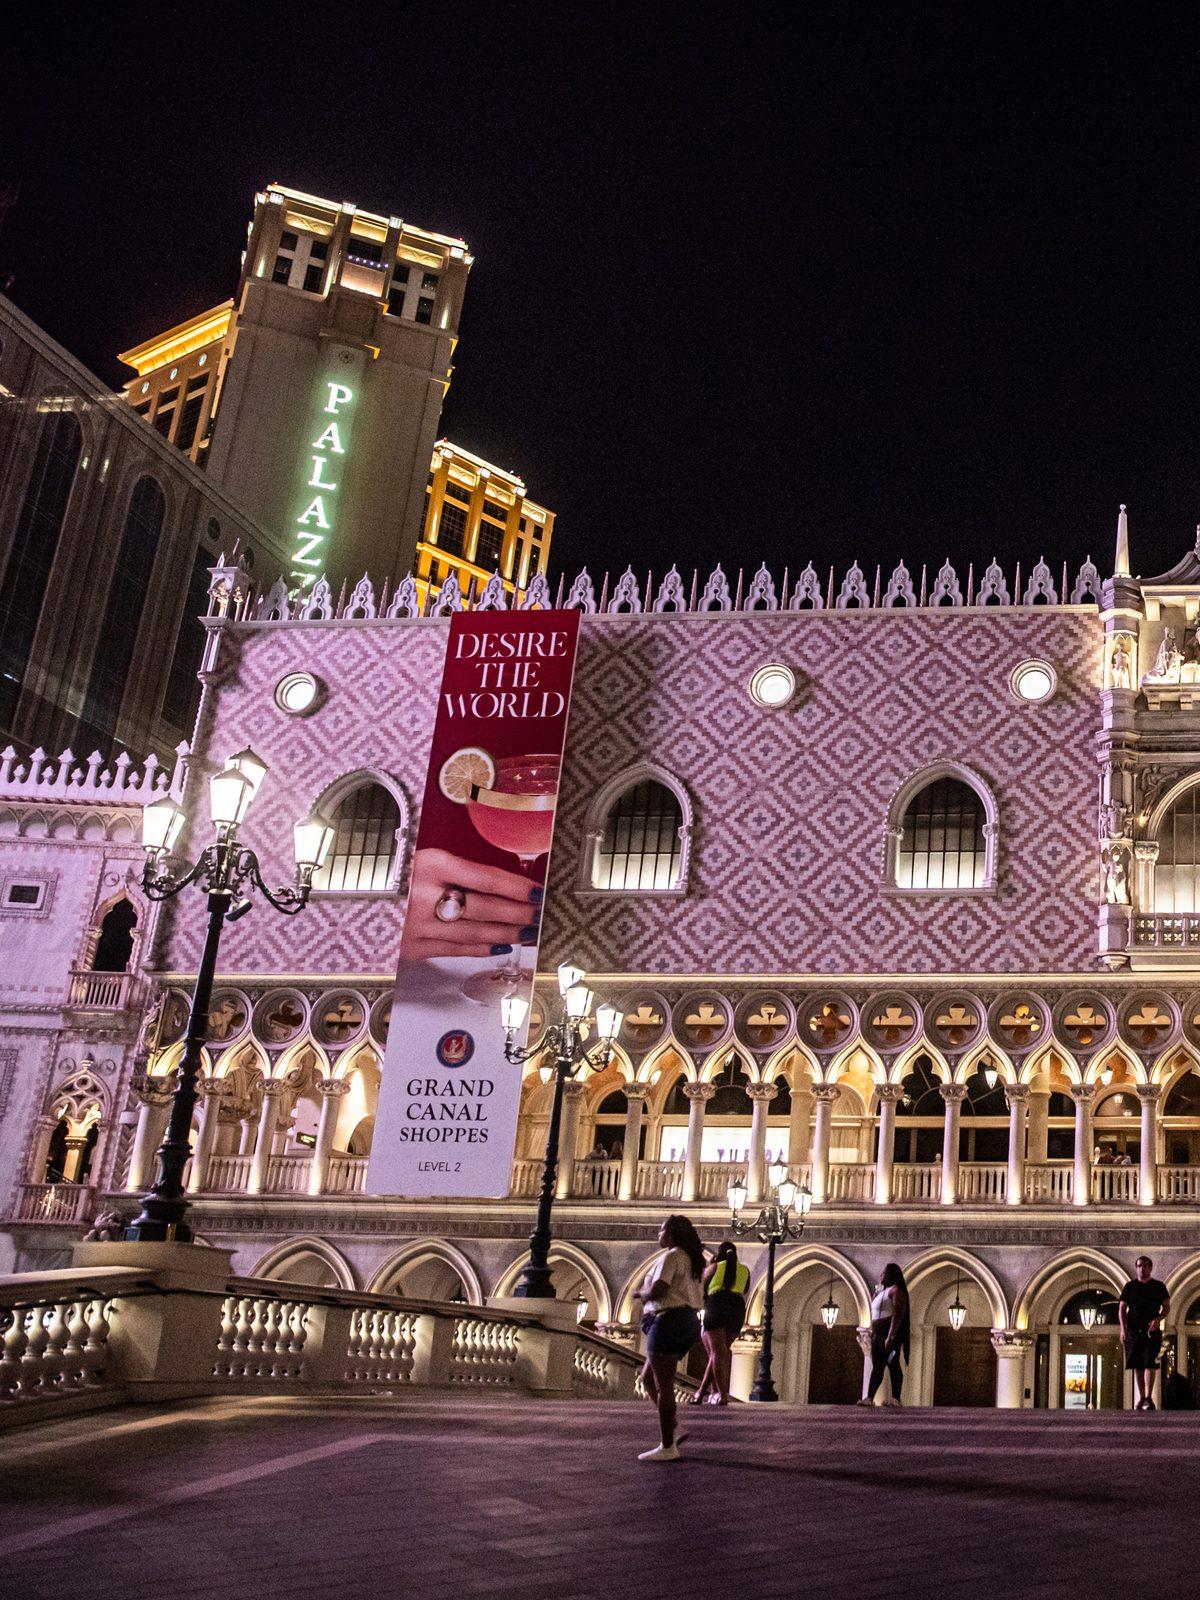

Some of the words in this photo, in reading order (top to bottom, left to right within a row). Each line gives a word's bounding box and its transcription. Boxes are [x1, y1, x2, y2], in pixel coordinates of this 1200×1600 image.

[454, 631, 568, 659] DESIRE
[474, 662, 541, 688] THE
[444, 691, 565, 719] WORLD
[406, 1078, 495, 1097] GRAND
[406, 1103, 488, 1121] CANAL
[400, 1127, 489, 1143] SHOPPES
[418, 1161, 451, 1172] LEVEL
[454, 1162, 461, 1172] 2
